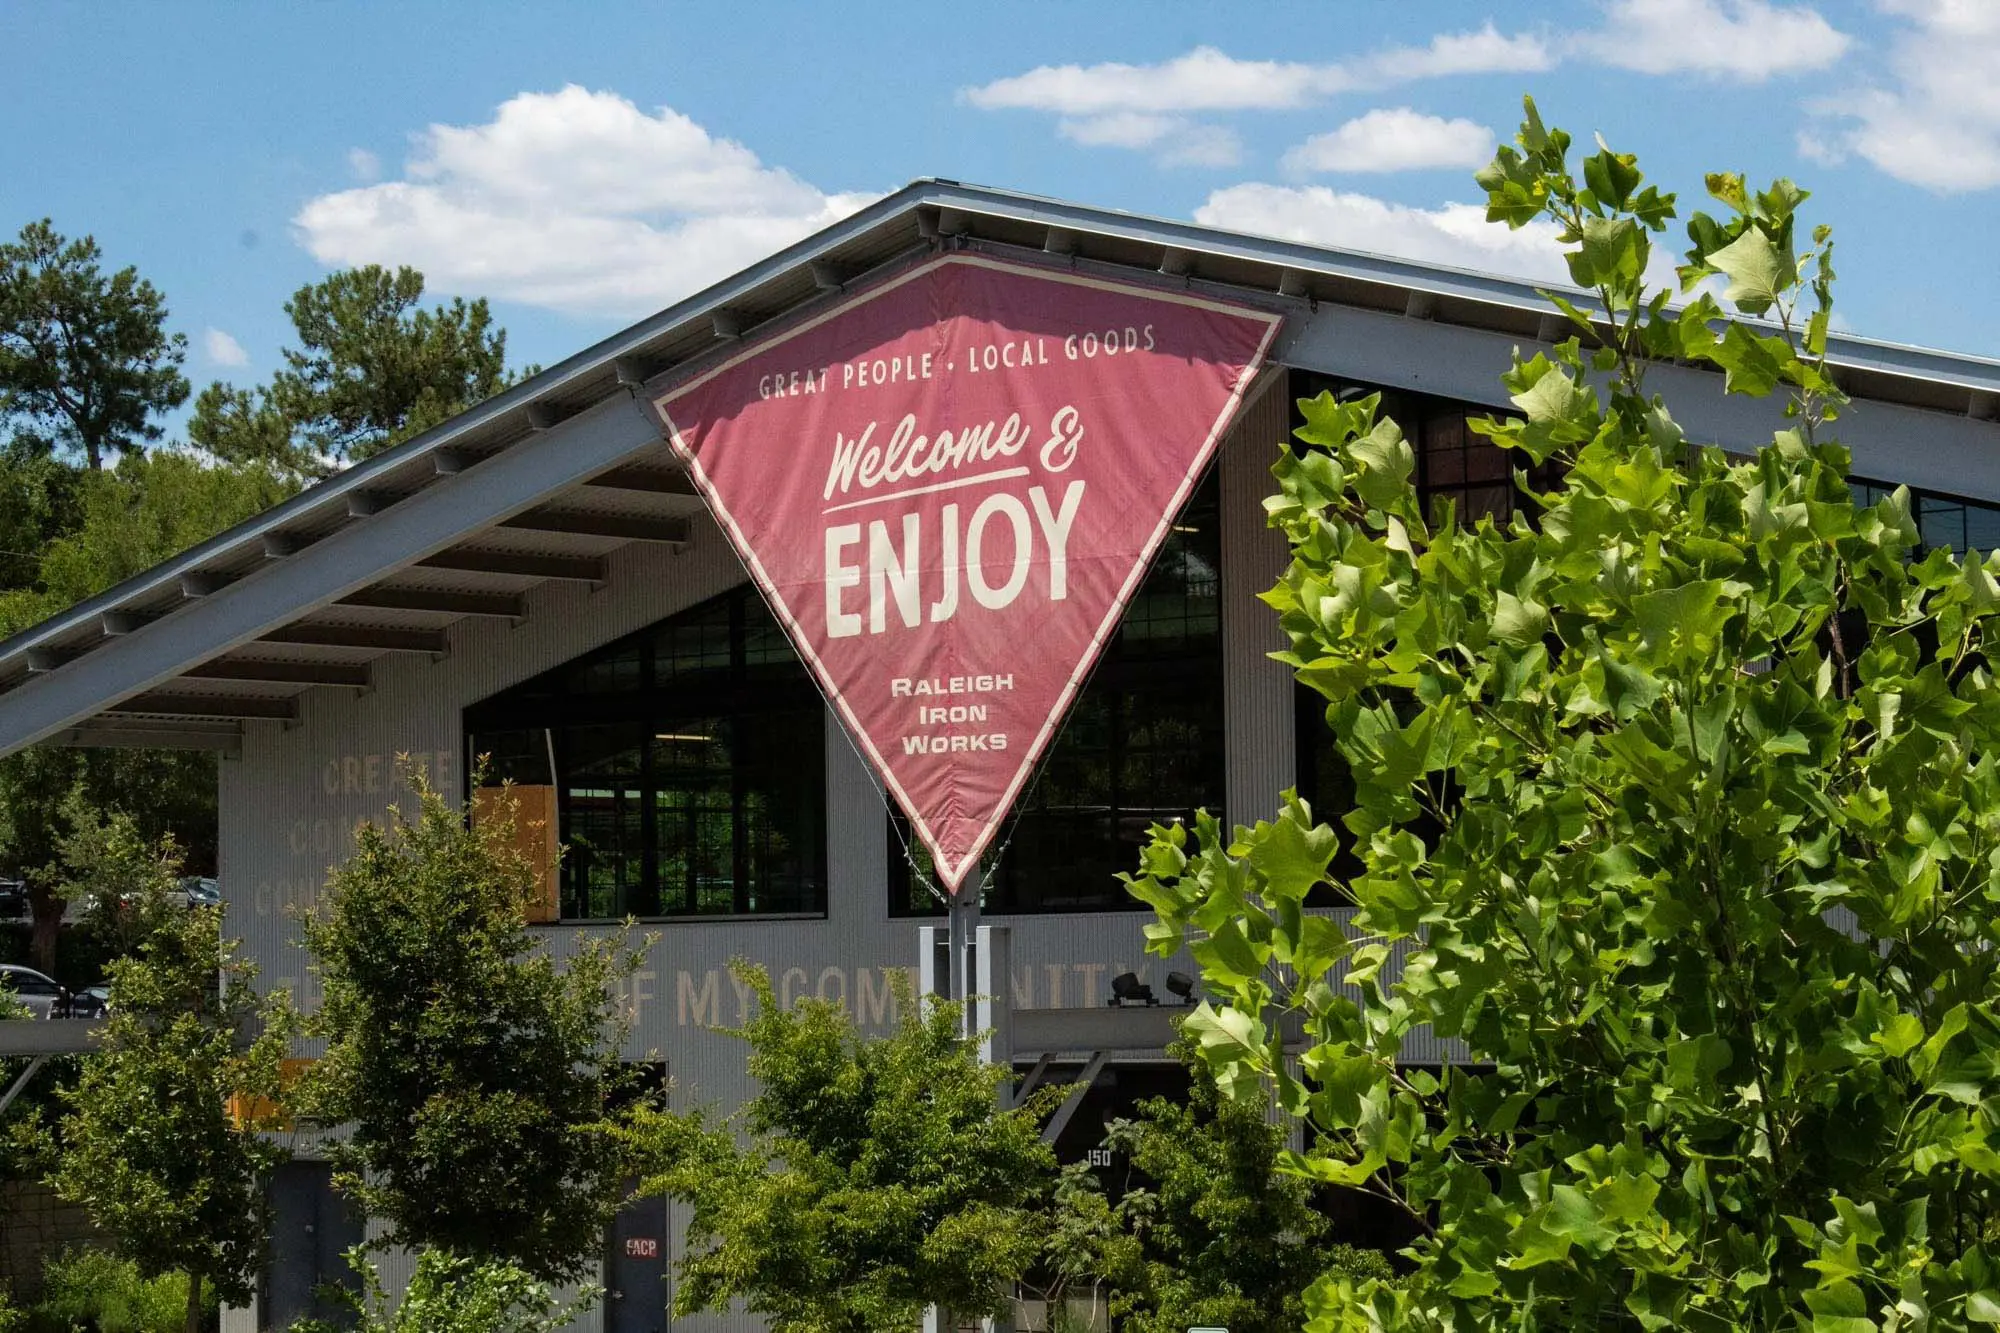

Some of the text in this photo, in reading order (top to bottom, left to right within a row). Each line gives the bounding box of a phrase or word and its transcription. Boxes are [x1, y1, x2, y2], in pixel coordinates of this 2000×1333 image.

[759, 324, 1155, 400] GREAT PEOPLE LOCAL GOODS
[823, 405, 1085, 501] Welcome &
[823, 480, 1086, 639] ENJOY
[891, 673, 1014, 698] RALEIGH
[919, 704, 987, 725] IRON
[902, 733, 1008, 756] WORKS
[1088, 1150, 1111, 1167] 150
